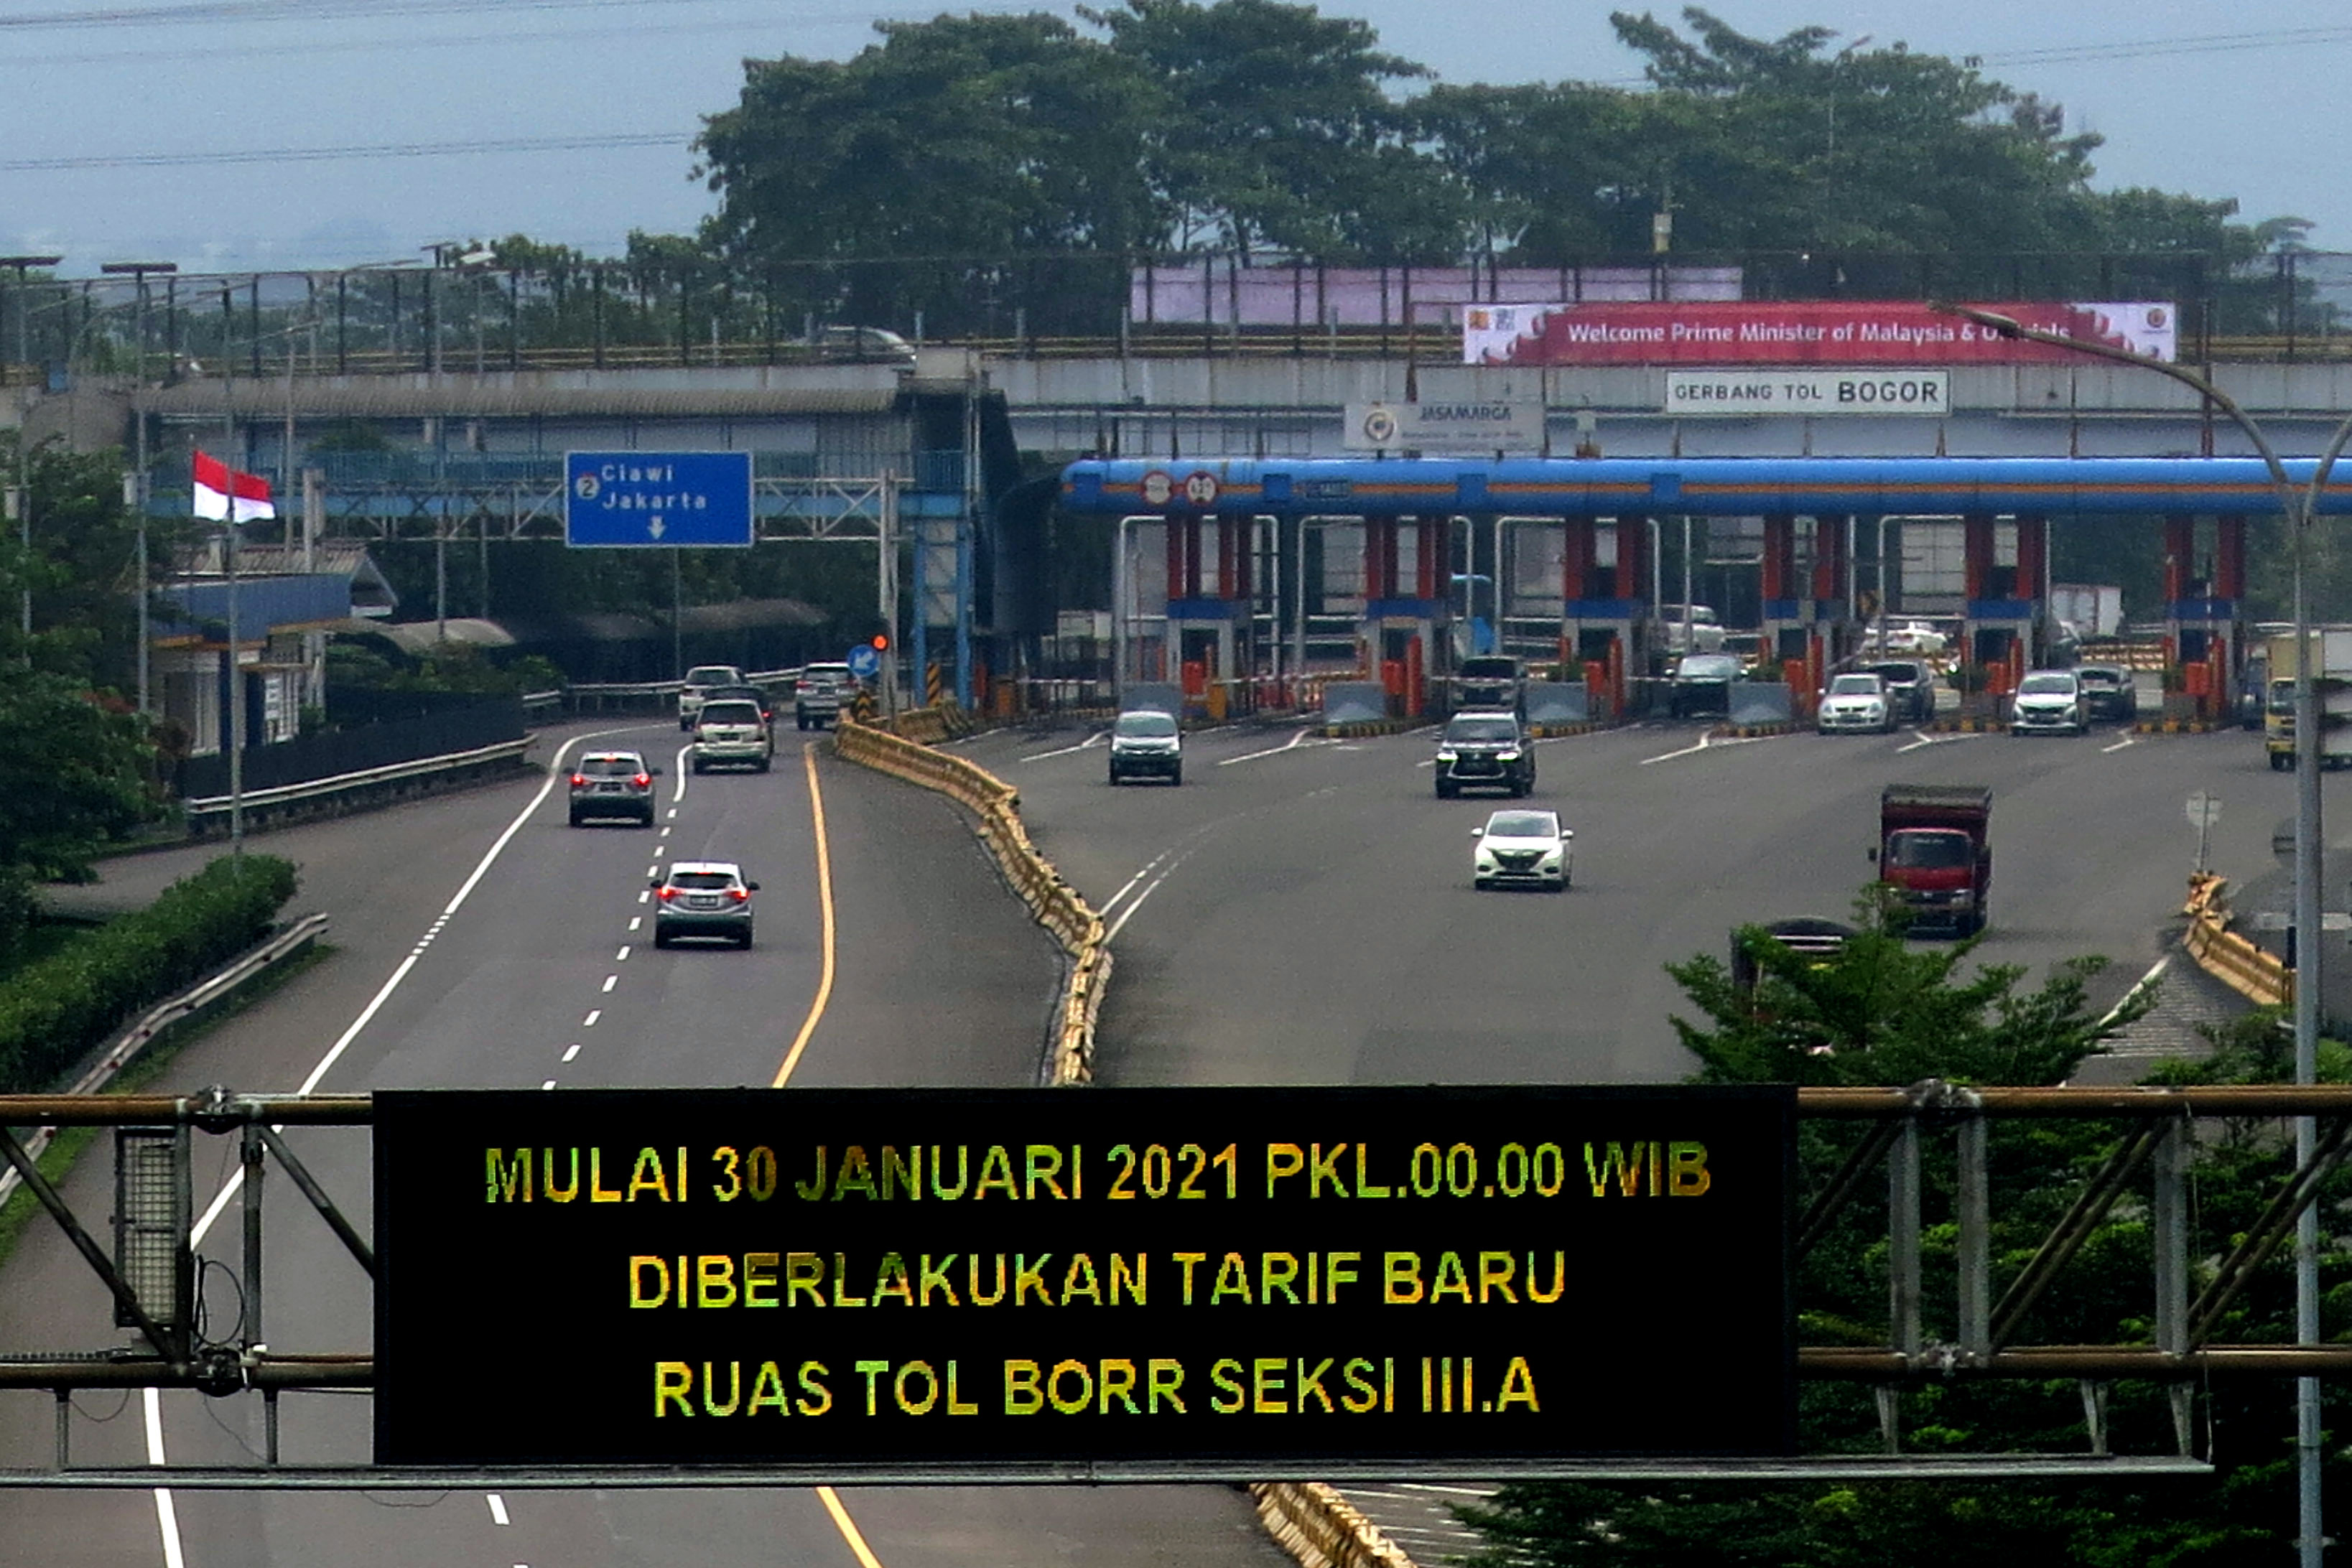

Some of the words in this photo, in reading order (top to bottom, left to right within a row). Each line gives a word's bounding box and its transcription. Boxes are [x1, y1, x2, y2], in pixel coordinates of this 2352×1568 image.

[1568, 322, 1664, 342] Welcome
[1671, 322, 1733, 342] Prime
[1739, 322, 1826, 342] Minister
[1832, 322, 1854, 342] of
[1859, 322, 1954, 346] Malaysia
[1961, 323, 1974, 341] &
[1675, 384, 1772, 400] GERBANG
[1785, 385, 1822, 399] TOL
[1839, 381, 1938, 403] BOGOR
[601, 465, 673, 482] Ciawi
[582, 479, 593, 497] 2
[603, 492, 707, 510] Jakarta
[486, 1147, 687, 1203] MULAI
[712, 1146, 776, 1202] 30
[795, 1144, 1082, 1200] JANUARI
[1107, 1143, 1237, 1199] 2021
[1268, 1142, 1564, 1198] PKL.00.00
[1584, 1142, 1711, 1198] WIB
[630, 1252, 1147, 1308] DIBERLAKUKAN
[1172, 1251, 1361, 1305] TARIF
[1384, 1251, 1564, 1304] BARU
[655, 1361, 832, 1417] RUAS
[855, 1360, 978, 1416] TOL
[1005, 1358, 1188, 1415] BORR
[1211, 1358, 1394, 1414] SEKSI
[1422, 1356, 1540, 1412] III.A
